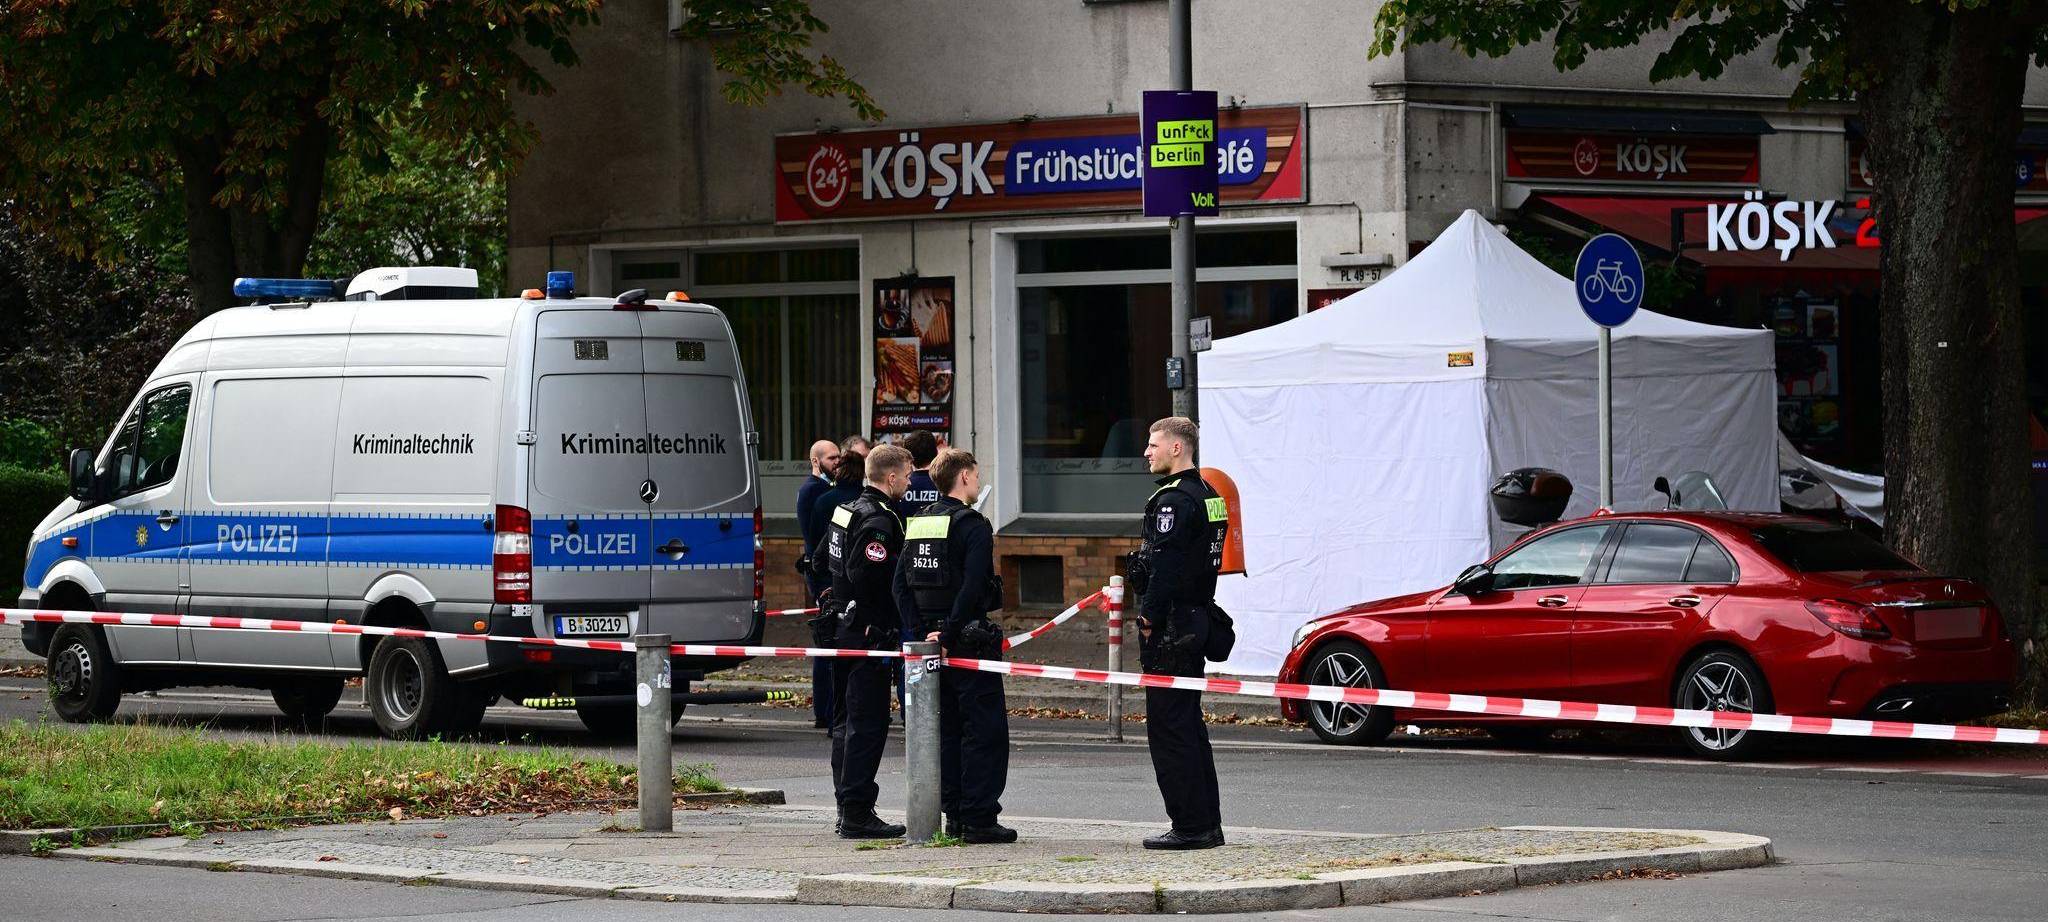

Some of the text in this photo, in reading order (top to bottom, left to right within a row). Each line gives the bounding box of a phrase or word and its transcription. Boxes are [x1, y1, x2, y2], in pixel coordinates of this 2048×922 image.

[1156, 147, 1201, 163] berlin
[1579, 138, 1688, 179] 24 KÖŞK
[815, 168, 839, 188] 24
[862, 132, 995, 211] KÖŞK
[1218, 139, 1254, 175] afé
[1191, 192, 1215, 208] Volt
[1707, 190, 1882, 262] KÖŞK 2
[1341, 270, 1351, 281] PL
[353, 434, 474, 455] Kriminaltechnik
[561, 433, 726, 455] Kriminaltechnik
[905, 490, 938, 502] OLIZEI
[217, 524, 298, 553] POLIZEI
[550, 533, 636, 555] POLIZEI
[832, 531, 839, 544] BE
[919, 544, 931, 555] BE
[913, 558, 938, 568] 36216
[569, 619, 577, 632] B
[585, 618, 622, 632] 30219
